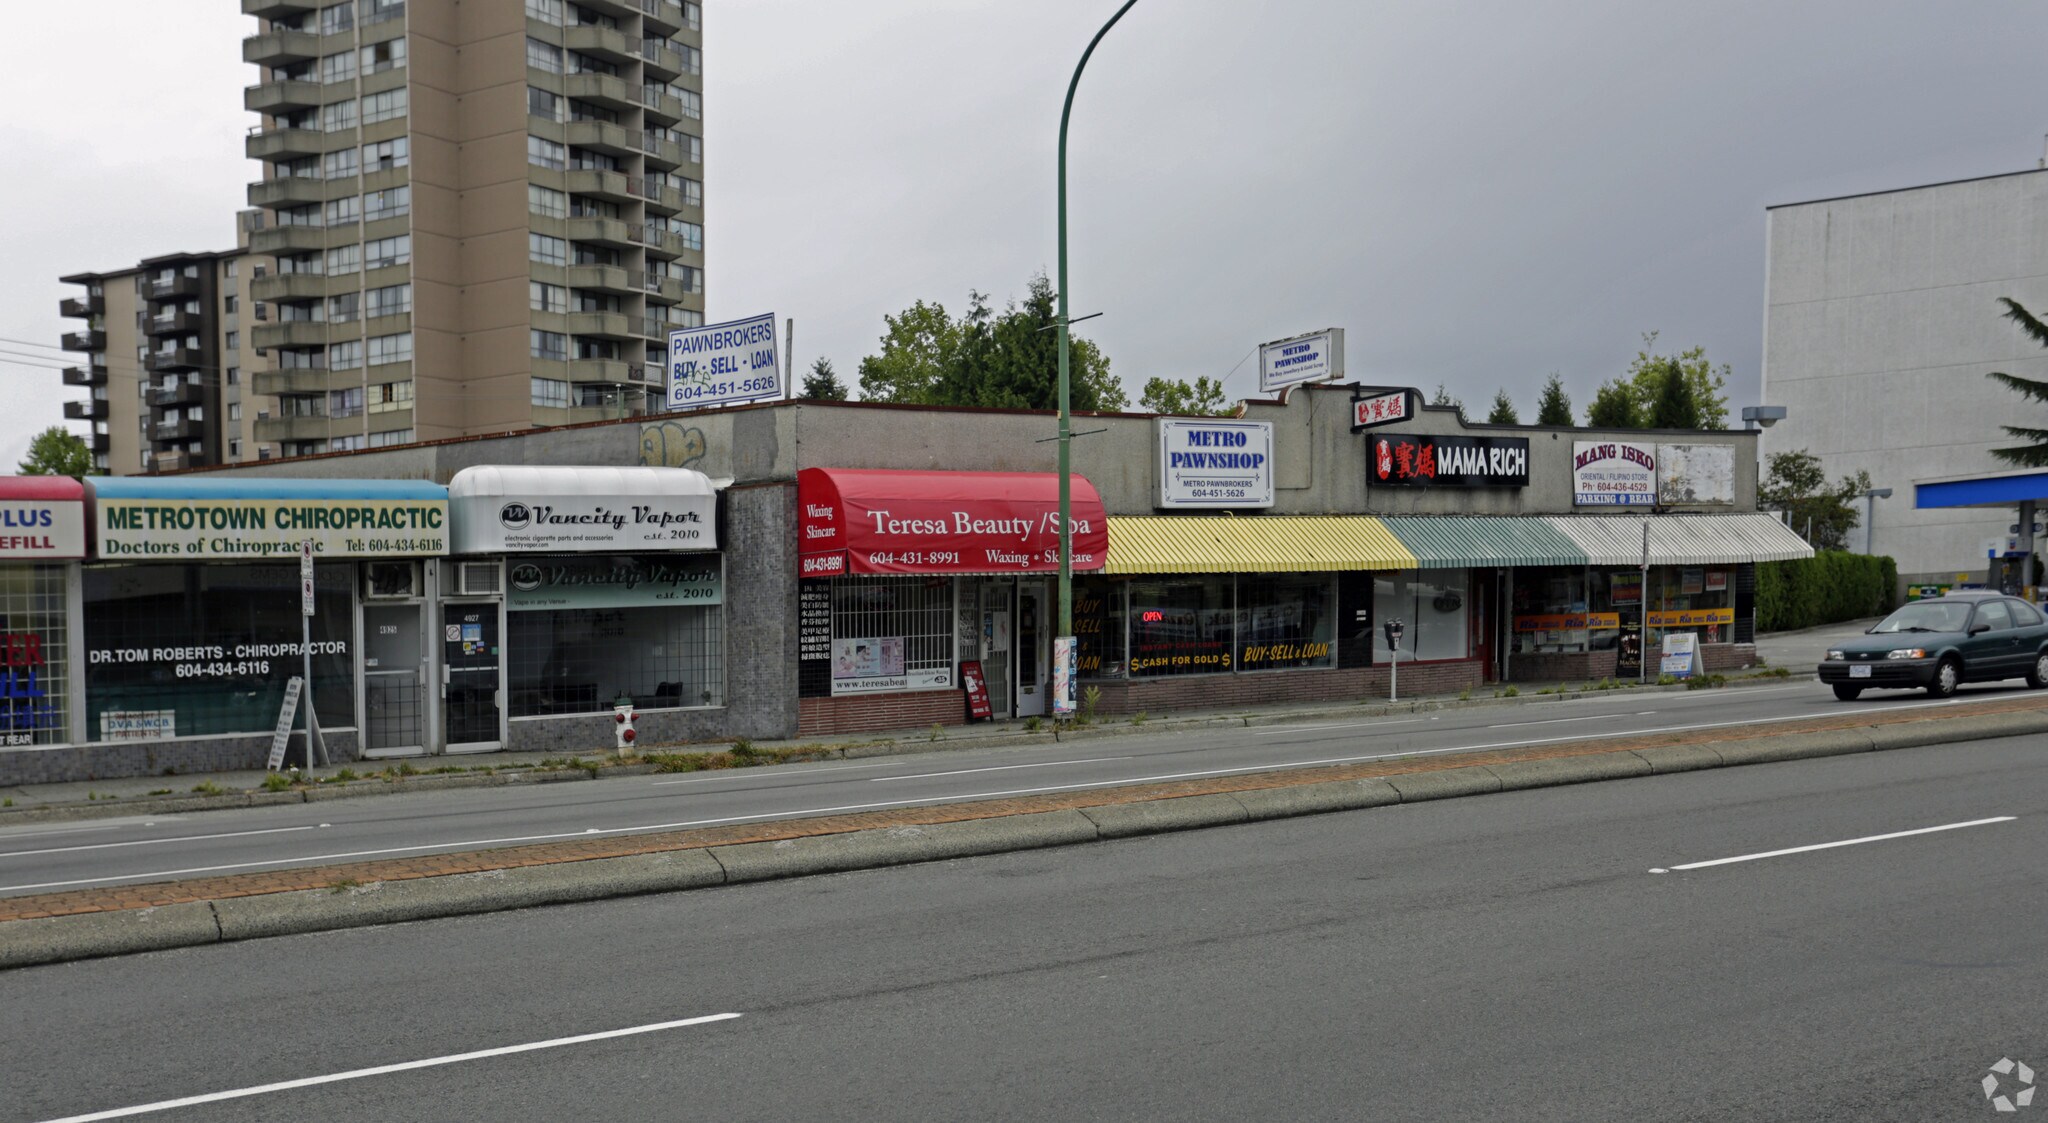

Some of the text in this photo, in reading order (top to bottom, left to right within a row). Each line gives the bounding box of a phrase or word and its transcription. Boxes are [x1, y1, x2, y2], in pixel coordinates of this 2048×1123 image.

[673, 323, 772, 356] PAWNBROKERS
[1282, 343, 1311, 357] METRO
[674, 360, 697, 380] BUY
[710, 355, 739, 375] SELL
[750, 348, 774, 370] LOAN
[1274, 351, 1319, 369] PAWNSHOP
[674, 376, 775, 401] 604-451-5626
[1187, 430, 1247, 448] METRO
[1170, 452, 1265, 470] PAWNSHOP
[1437, 446, 1526, 477] MAMA RICH
[1575, 444, 1655, 472] MANG ISKO
[1183, 480, 1253, 488] METRO PAWNBROKERS
[1580, 473, 1605, 481] ORIENTAL
[1610, 473, 1630, 481] FILIPINO
[1631, 473, 1648, 481] STORE
[1191, 489, 1245, 498] 604-451-5626
[1597, 483, 1647, 492] 604-436-4529
[1576, 494, 1654, 504] PARKING @ REAR
[0, 508, 53, 528] LUS
[106, 506, 442, 530] METROTOWN CHIROPRACTIC
[532, 504, 630, 531] Vancity
[631, 504, 703, 529] Vapor
[806, 503, 833, 520] Waxing
[806, 525, 836, 540] Skincare
[867, 510, 1092, 541] Teresa Beauty /Sa
[0, 536, 55, 550] EFILL
[532, 535, 557, 543] cigarette
[643, 530, 700, 541] est. 2010
[105, 537, 443, 557] Doctors of Chiropracic Tel: 604-434-6116
[803, 556, 843, 573] 604-431-8991
[869, 548, 1093, 567] 604-431-8991 Waxing Skcare
[547, 565, 642, 590] Vancity
[643, 564, 717, 588] Vapor
[656, 588, 714, 600] est. 2010
[1074, 600, 1101, 614] BUY
[1143, 611, 1162, 622] OPEN
[1589, 615, 1602, 627] Ria
[1649, 614, 1662, 624] Ria
[1680, 613, 1692, 624] Ria
[1706, 612, 1718, 622] Ria
[1073, 619, 1101, 634] SELL
[89, 649, 149, 664] DR.TOM
[152, 646, 223, 662] ROBERTS
[235, 641, 346, 660] CHIROPRACTOR
[1301, 643, 1329, 659] LOAN
[175, 660, 270, 677] 604-434-6116
[1077, 655, 1101, 672] OAN
[1130, 652, 1231, 672] $ CASH FOR GOLD $
[6, 735, 31, 745] REAR
